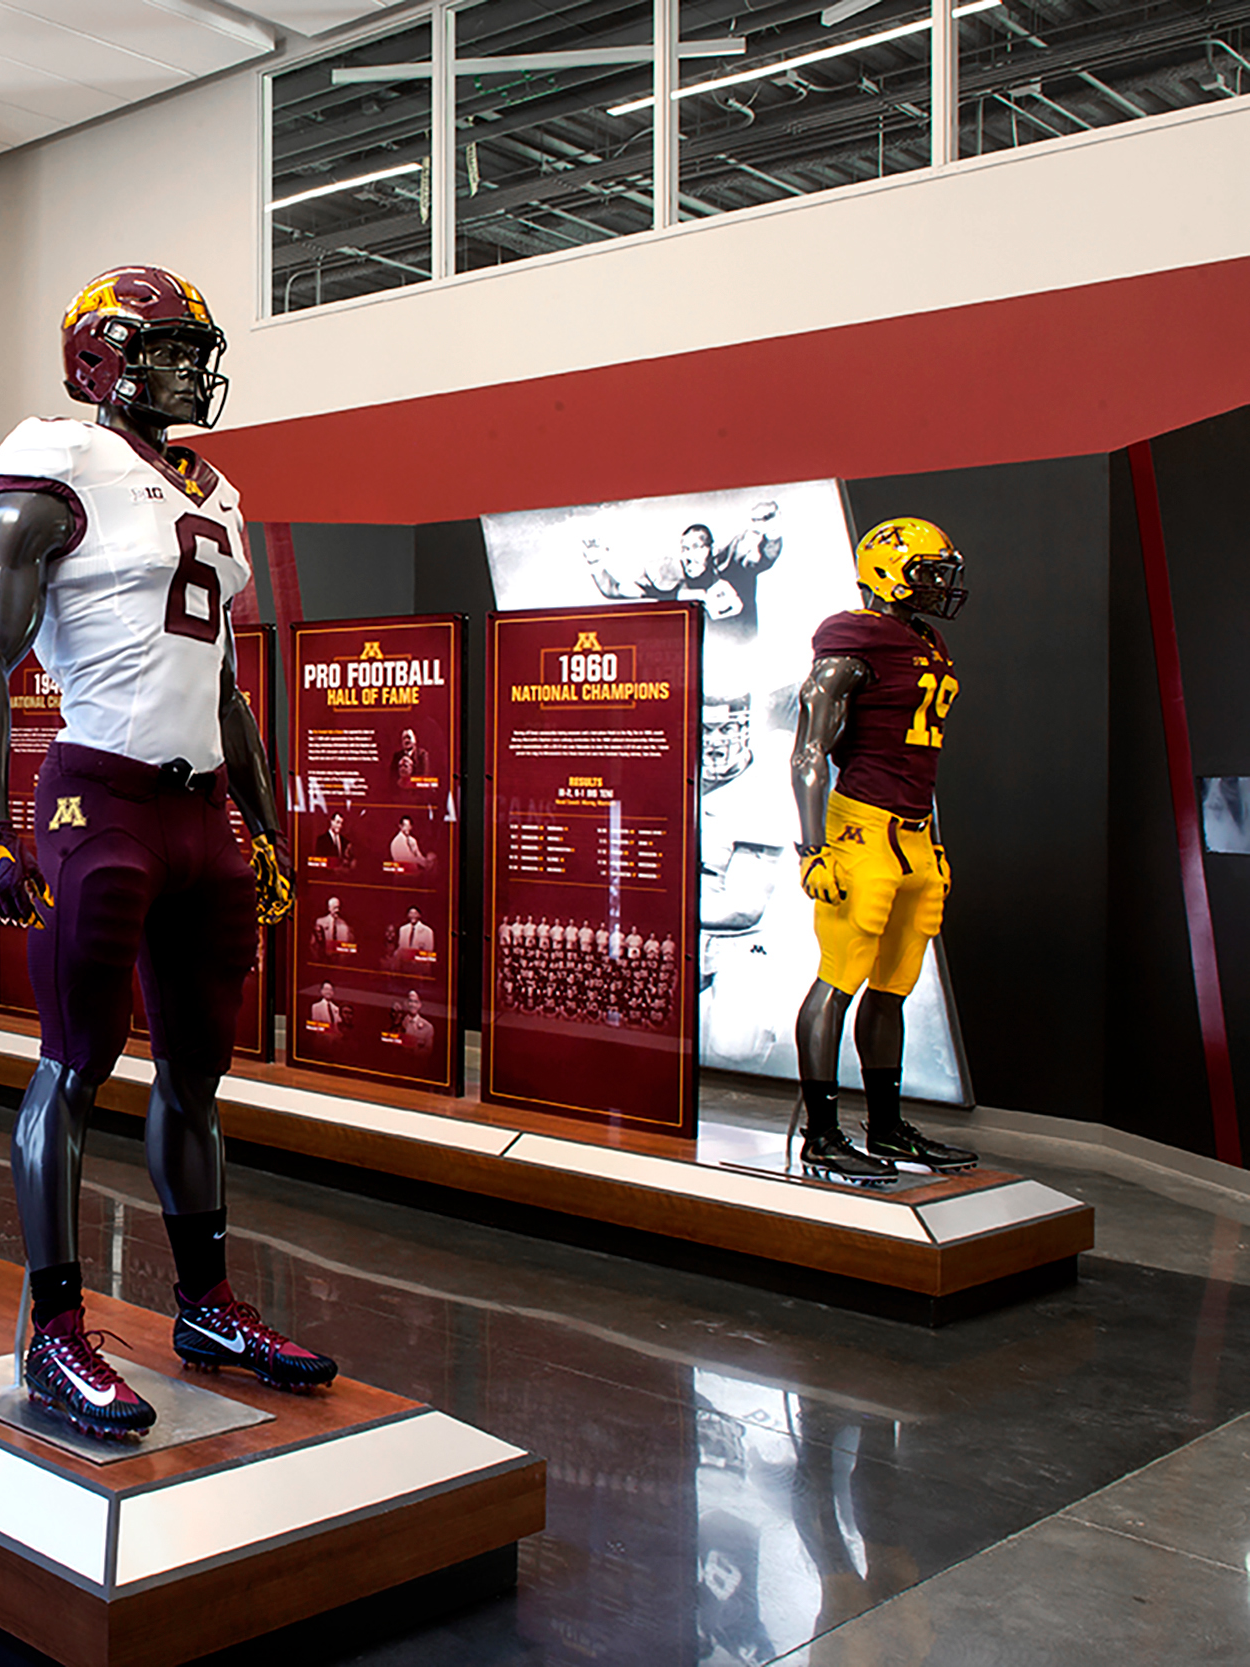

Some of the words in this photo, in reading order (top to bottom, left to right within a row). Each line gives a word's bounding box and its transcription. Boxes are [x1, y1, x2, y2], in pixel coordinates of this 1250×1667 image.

[164, 511, 233, 645] 6
[304, 663, 340, 689] PRO
[347, 659, 444, 687] FOOTBALL
[558, 653, 617, 683] 1960
[34, 673, 64, 695] 194
[327, 688, 358, 705] HALL
[362, 688, 379, 705] OF
[382, 686, 420, 704] FAME
[511, 684, 580, 702] NATIONAL
[582, 682, 669, 701] CHAMPIONS
